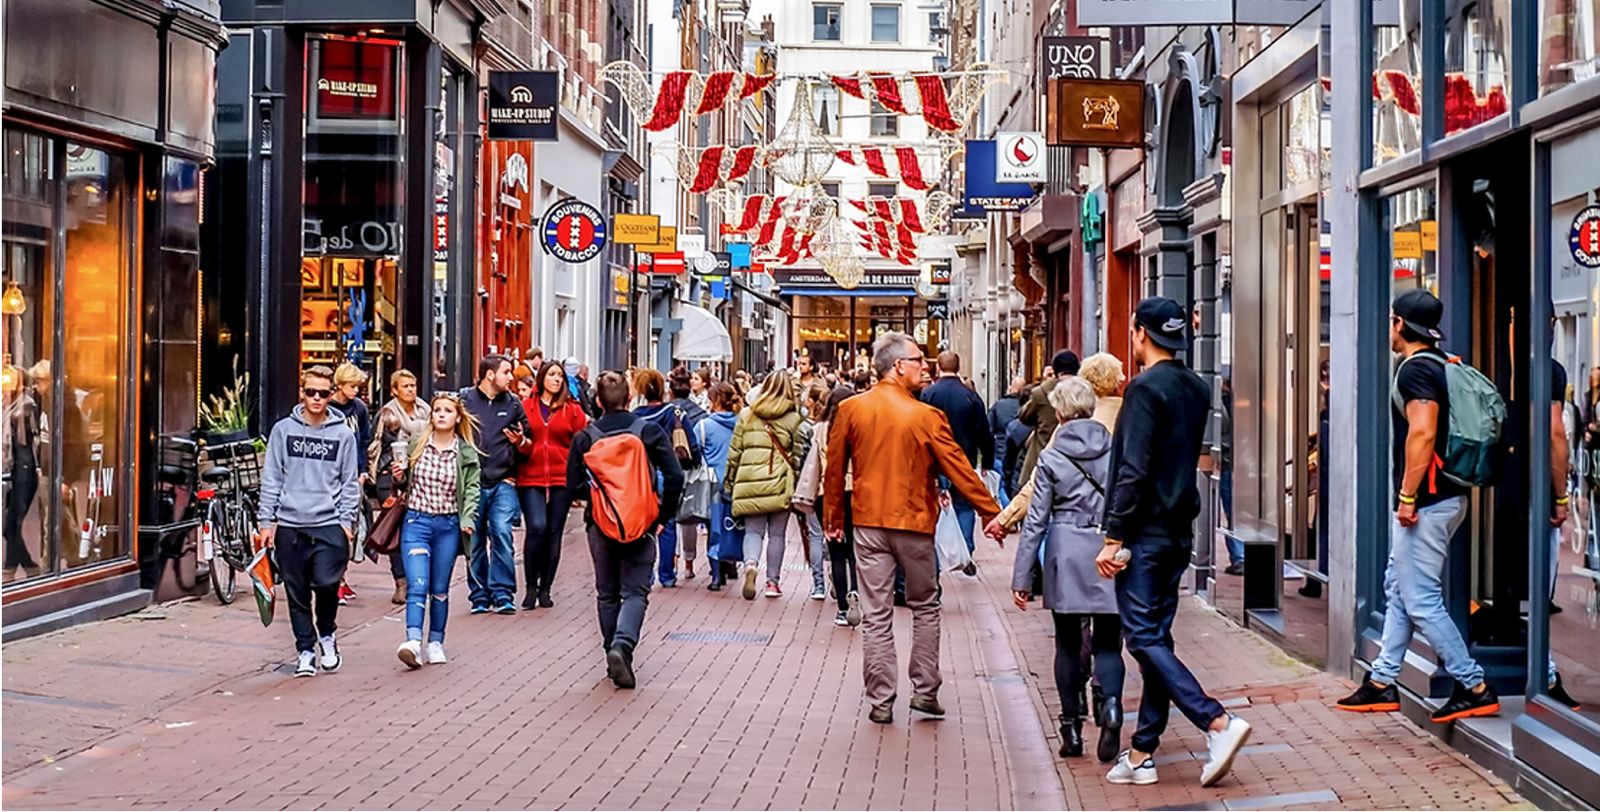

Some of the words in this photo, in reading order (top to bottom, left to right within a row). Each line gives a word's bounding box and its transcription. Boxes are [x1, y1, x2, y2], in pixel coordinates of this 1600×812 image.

[1048, 44, 1095, 64] UNO
[491, 108, 524, 118] MAKE-UP
[524, 108, 551, 118] STUDIO
[969, 197, 1000, 205] STATE
[551, 204, 602, 226] SOUVENIRS
[553, 242, 598, 260] TOBACCO
[789, 275, 832, 283] AMSTERDAM
[293, 440, 328, 457] snipes
